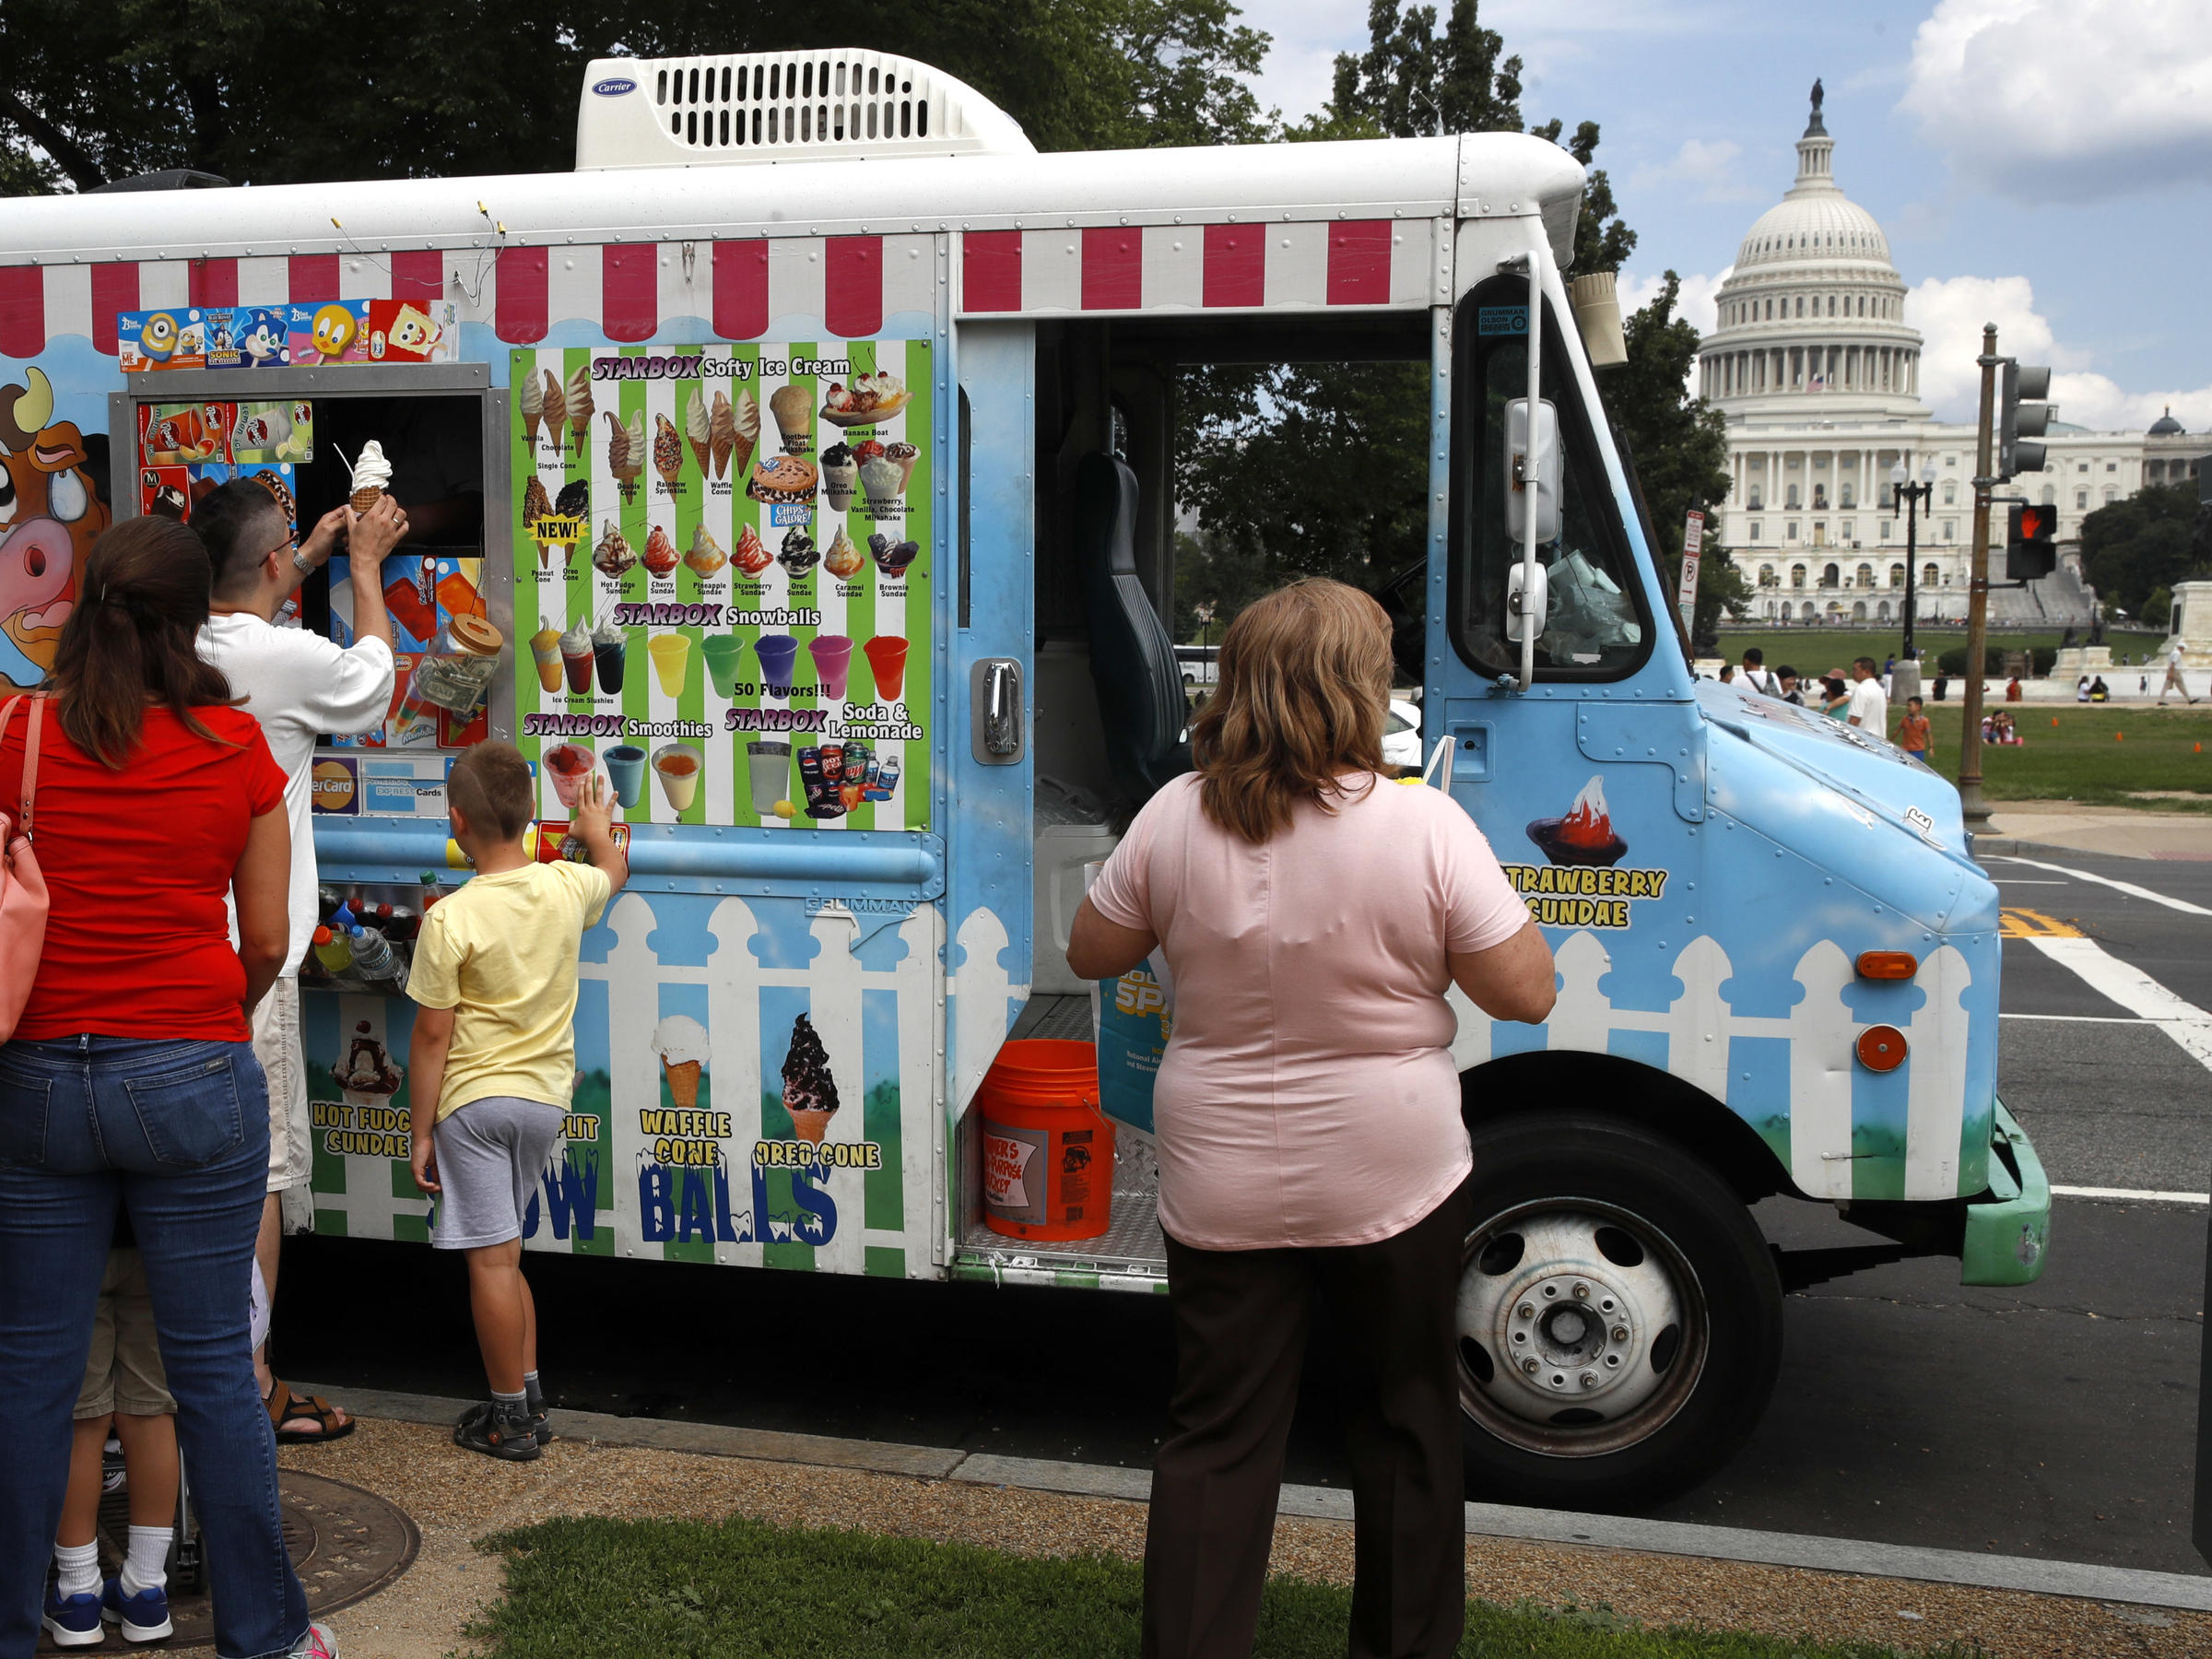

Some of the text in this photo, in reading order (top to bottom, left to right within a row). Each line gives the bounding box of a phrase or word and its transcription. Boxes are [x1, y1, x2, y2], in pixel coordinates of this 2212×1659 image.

[598, 83, 631, 92] Carrier
[210, 350, 240, 359] SONIC
[592, 356, 851, 381] STARBOX Softy Ice Cream
[146, 472, 157, 483] M
[775, 512, 811, 524] GALORE!
[776, 506, 804, 516] CHIPS
[537, 522, 579, 538] NEW!
[613, 603, 822, 627] STARBOX Snowballs
[734, 683, 831, 697] 50 Flavors!!!
[724, 708, 829, 732] STARBOX
[842, 702, 909, 722] Soda &
[524, 713, 713, 737] STARBOX Smoothies
[830, 721, 924, 740] Lemonade
[312, 779, 352, 793] erCard
[376, 786, 442, 796] EXPRESS Cards
[806, 899, 917, 914] GRUMMAN
[312, 1104, 411, 1133] HOT FUDG
[640, 1110, 732, 1137] WAFFLE
[326, 1132, 409, 1158] SUNDAE
[654, 1139, 719, 1166] CONE
[755, 1141, 880, 1169] OREO CONE
[636, 1147, 838, 1246] BALLS
